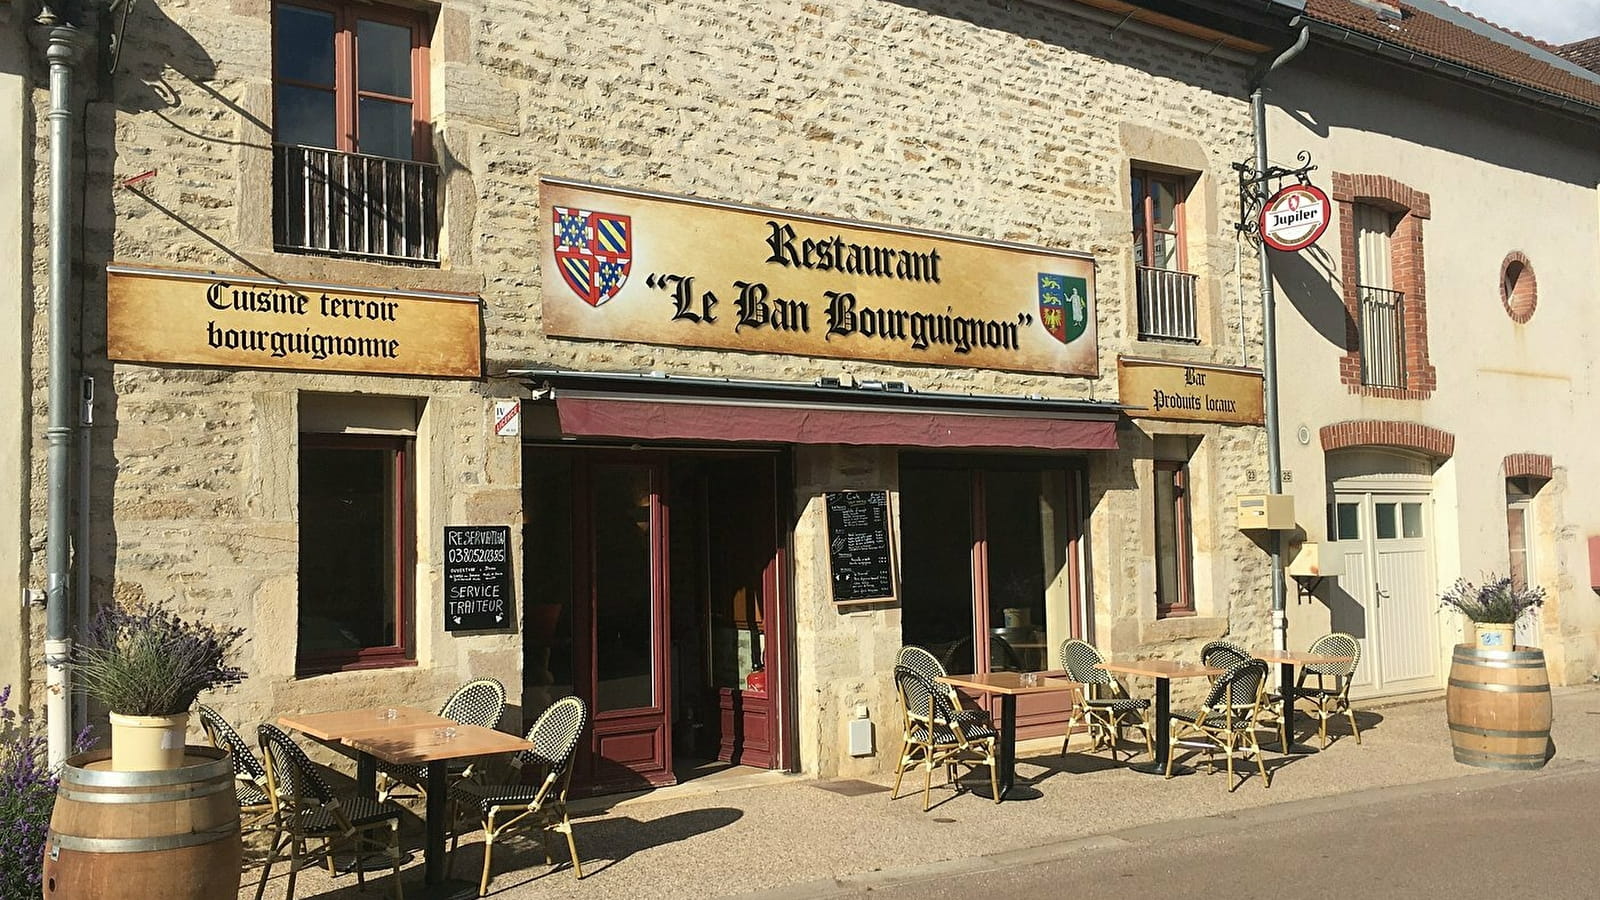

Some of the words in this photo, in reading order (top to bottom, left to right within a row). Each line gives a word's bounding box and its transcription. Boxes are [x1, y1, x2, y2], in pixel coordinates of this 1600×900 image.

[1273, 210, 1318, 226] Jupiler
[765, 220, 942, 283] Restaurant
[207, 281, 309, 316] Cuisine
[320, 292, 399, 322] terroir
[732, 281, 810, 334] Ban
[207, 320, 399, 360] bourguignonne
[1184, 367, 1206, 387] Bar
[1153, 389, 1201, 411] Produits
[1205, 394, 1237, 413] locaux
[450, 584, 500, 598] SERVICE
[449, 599, 504, 615] TRAITEUR
